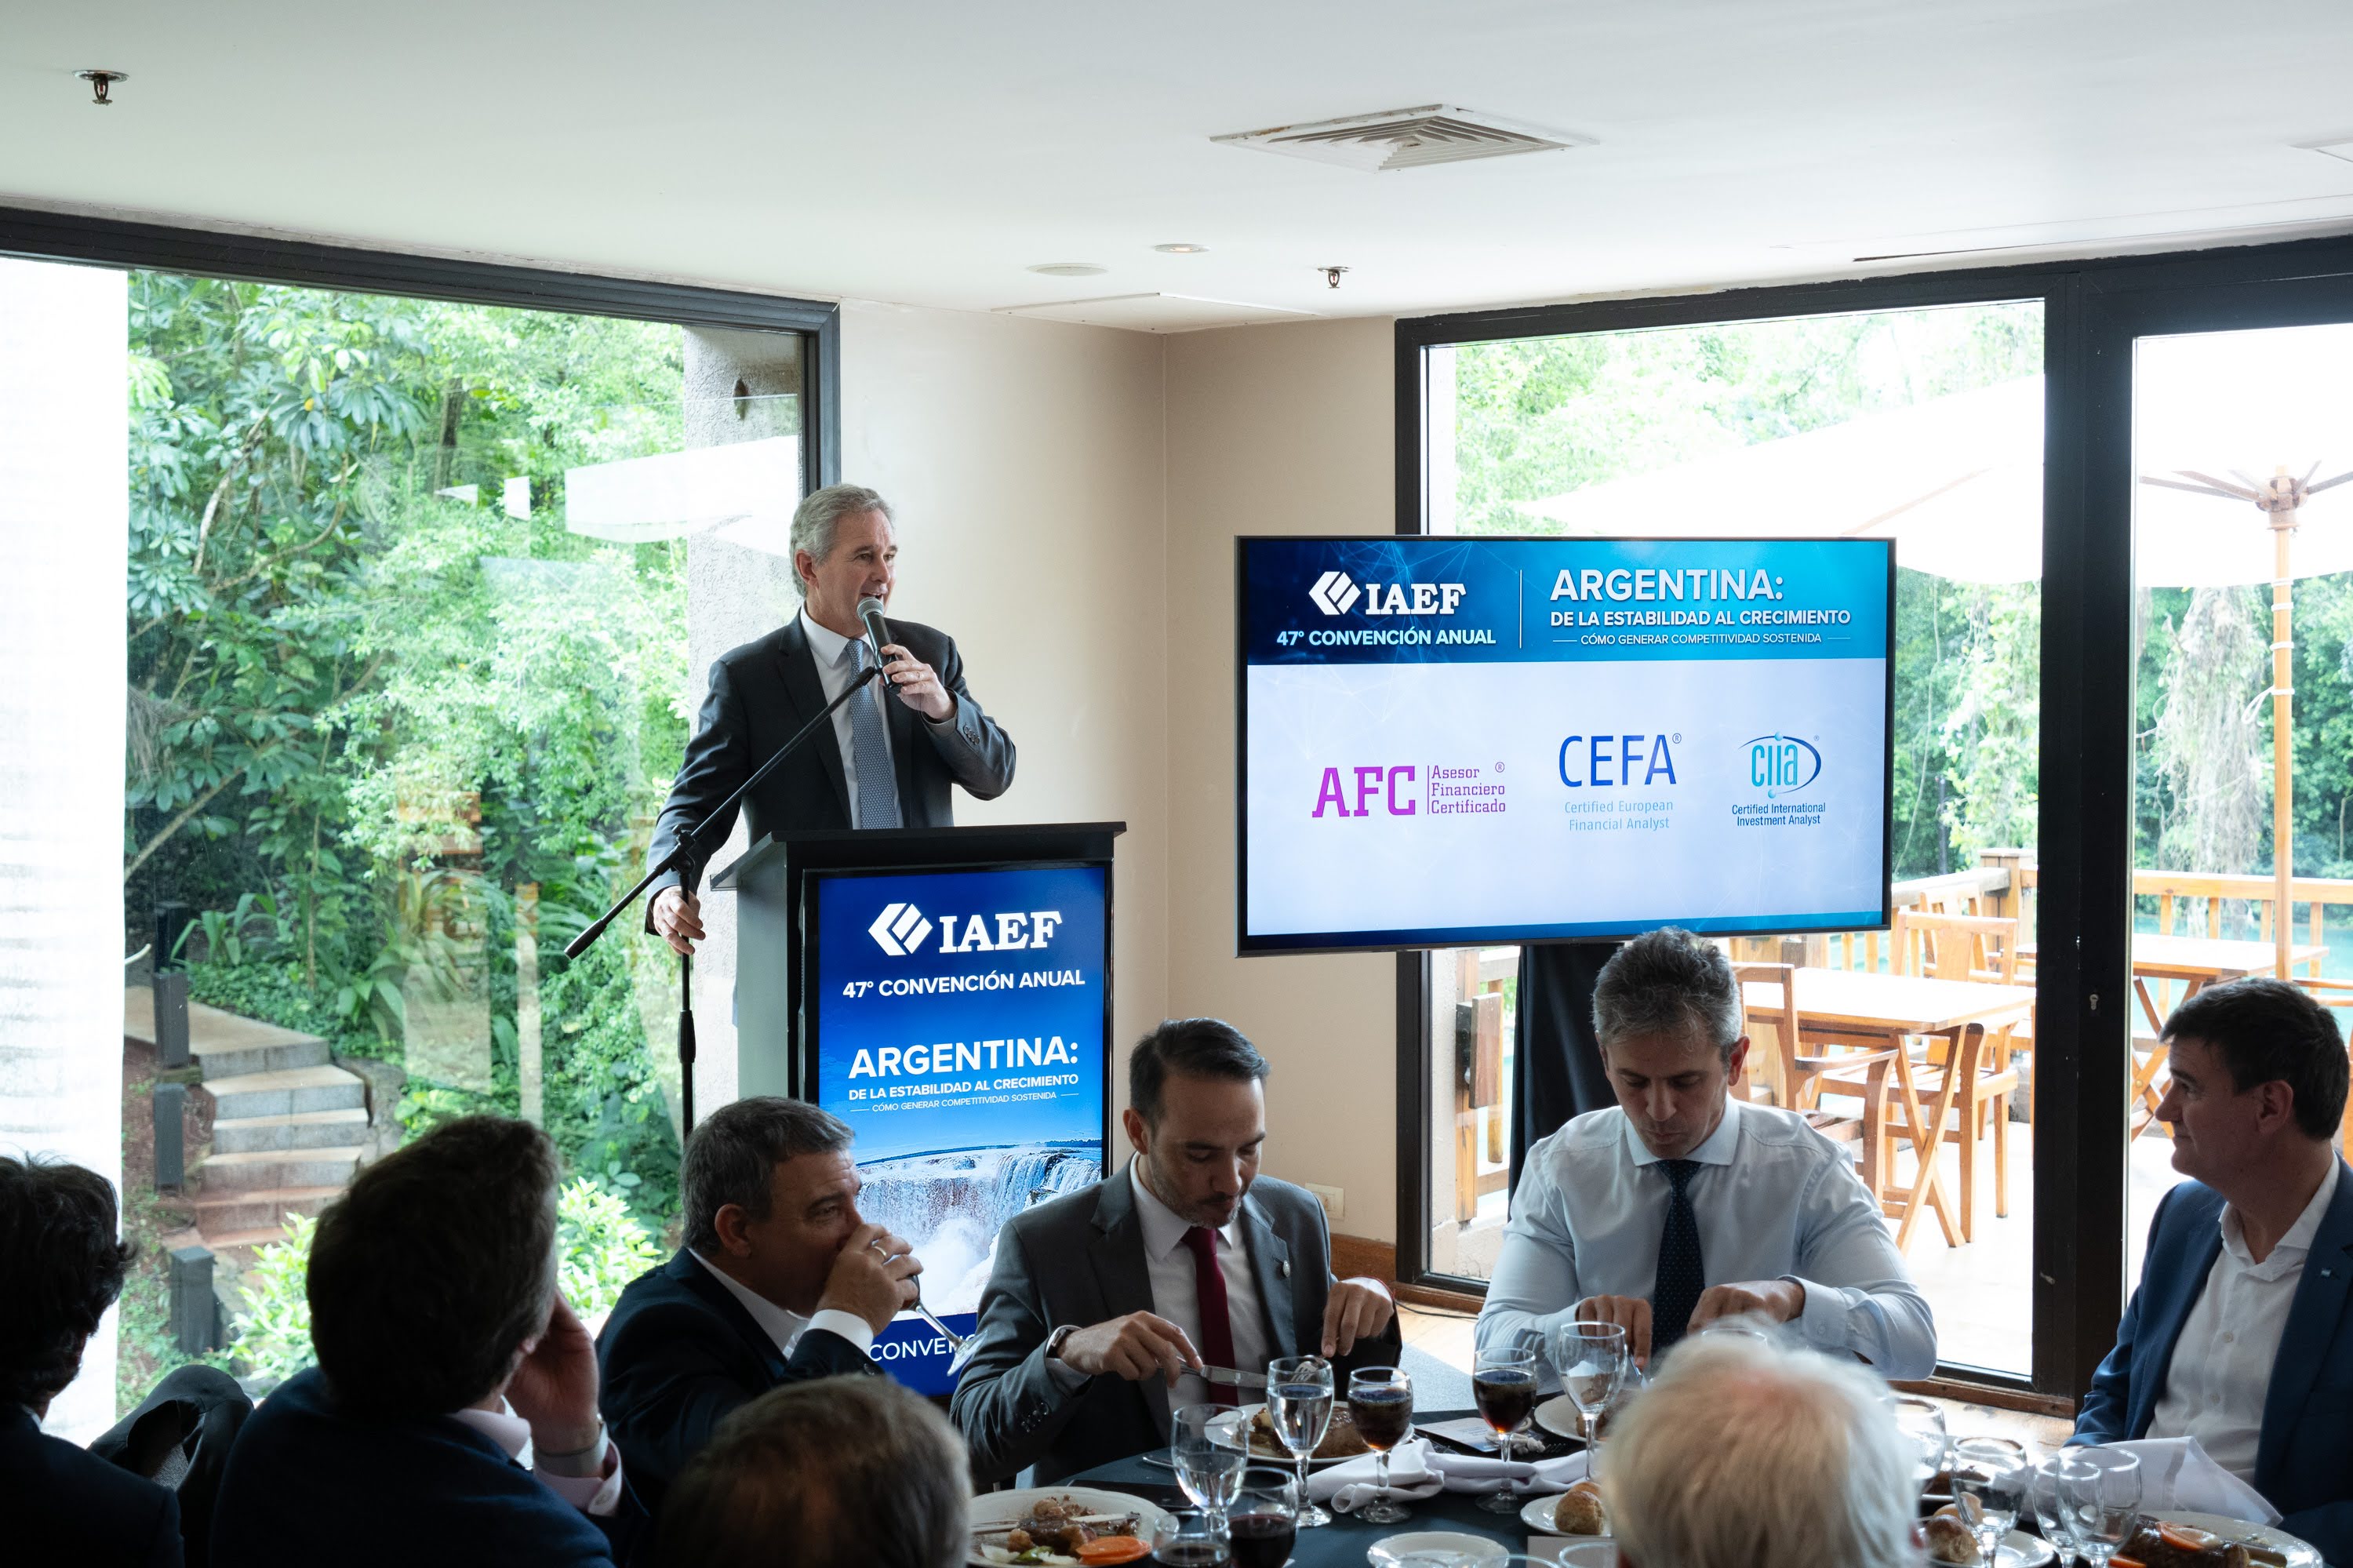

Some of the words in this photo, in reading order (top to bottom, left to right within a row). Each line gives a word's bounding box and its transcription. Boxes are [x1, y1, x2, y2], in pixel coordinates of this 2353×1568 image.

[1550, 569, 1784, 600] ARGENTINA:
[1366, 584, 1467, 615] IAEF
[1551, 611, 1574, 627] DE
[1579, 611, 1600, 627] LA
[1605, 610, 1711, 626] ESTABILIDAD
[1715, 610, 1736, 625] AL
[1739, 609, 1851, 625] CRECIMIENTO
[1309, 627, 1431, 646] CONVENCIÓN
[1435, 629, 1496, 645] ANUAL
[1580, 632, 1616, 645] CÓMO
[1618, 635, 1668, 645] GENERAR
[1671, 633, 1760, 644] COMPETITIVIDAD
[1762, 633, 1822, 643] SOSTENIDA
[1431, 766, 1480, 779] Asesor
[1312, 766, 1416, 817] AFC
[1431, 783, 1505, 796] Financiero
[1431, 799, 1506, 813] Certificado
[1565, 801, 1613, 813] Certified
[1619, 800, 1673, 813] European
[1732, 804, 1769, 815] Certified
[1772, 802, 1826, 814] International
[1569, 818, 1622, 831] Financial
[1627, 817, 1670, 831] Analyst
[1737, 816, 1786, 826] Investment
[1788, 814, 1820, 826] Analyst
[939, 911, 1063, 954] IAEF
[878, 970, 1013, 996] CONVENCIÓN
[1019, 970, 1086, 988] ANUAL
[848, 1036, 1078, 1079] ARGENTINA:
[849, 1089, 867, 1101] DE
[870, 1087, 887, 1099] LA
[889, 1082, 972, 1098] ESTABILIDAD
[974, 1080, 991, 1092] AL
[993, 1074, 1079, 1090] CRECIMIENTO
[872, 1101, 900, 1112] CÓMO
[901, 1099, 940, 1111] GENERAR
[941, 1094, 1010, 1108] COMPETITIVIDAD
[1011, 1091, 1057, 1103] SOSTENIDA
